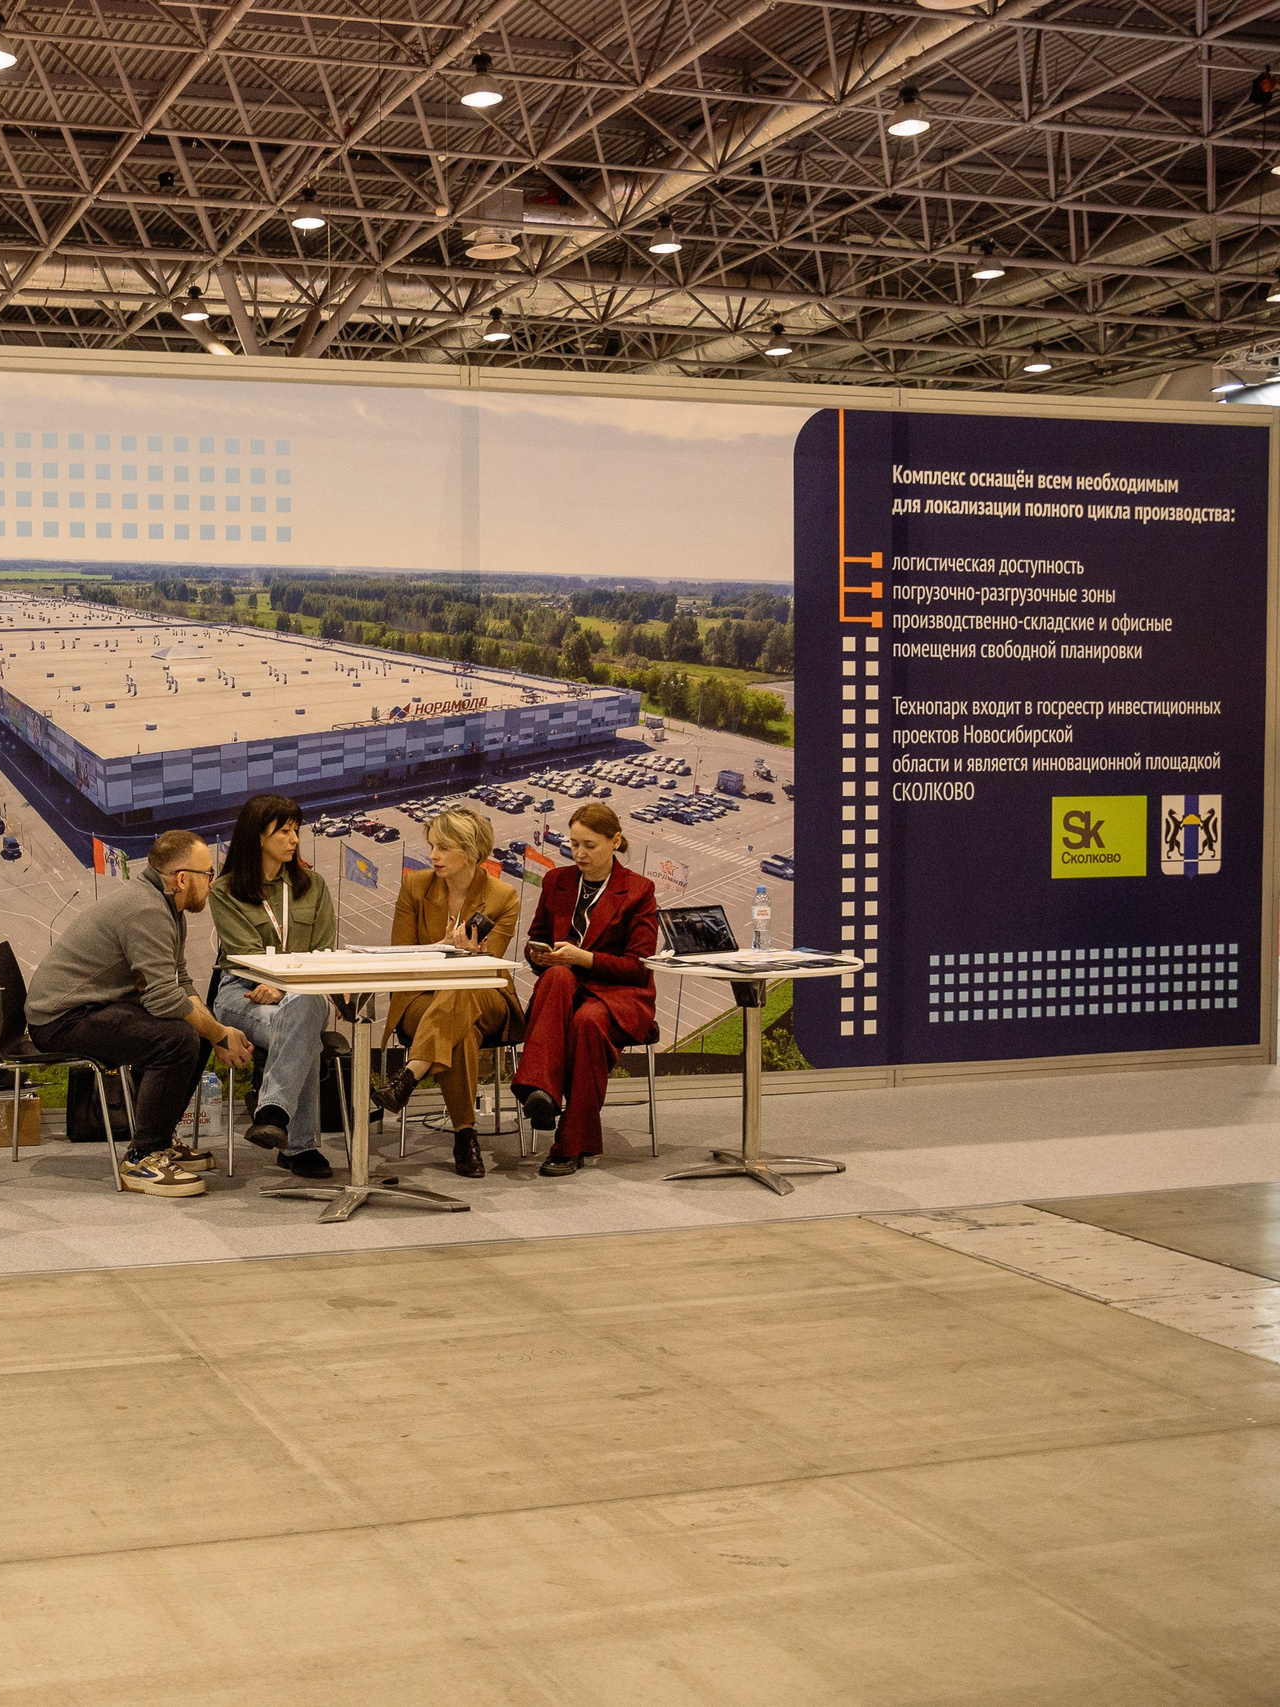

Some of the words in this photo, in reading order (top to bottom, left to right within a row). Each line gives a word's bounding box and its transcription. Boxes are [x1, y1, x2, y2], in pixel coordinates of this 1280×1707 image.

[892, 464, 967, 487] Комплекс
[968, 468, 1034, 491] оснащён
[1037, 474, 1073, 490] всем
[1075, 471, 1179, 495] необходимым
[891, 498, 922, 516] для
[923, 499, 1022, 519] локализации
[1024, 502, 1085, 519] полного
[1087, 504, 1131, 522] цикла
[1134, 505, 1236, 525] производства:
[891, 556, 996, 573] логистическая
[998, 558, 1085, 579] доступность
[892, 585, 1078, 607] погрузочно-разгрузочные
[1081, 588, 1116, 604] зоны
[892, 613, 1095, 634] производственно-складские
[1098, 617, 1108, 631] и
[1110, 612, 1173, 636] офисные
[892, 642, 977, 661] помещения
[980, 639, 1057, 662] свободной
[1060, 644, 1143, 664] планировки
[892, 695, 969, 720] Технопарк
[972, 700, 1022, 718] входит
[1024, 700, 1033, 716] в
[1036, 700, 1105, 720] госреестр
[1107, 700, 1222, 718] инвестиционных
[892, 729, 960, 749] проектов
[963, 724, 1074, 748] Новосибирской
[892, 753, 950, 773] области
[953, 758, 963, 772] и
[966, 757, 1029, 773] является
[1032, 752, 1142, 774] инновационной
[1145, 751, 1221, 773] площадкой
[892, 781, 975, 802] СКОЛКОВО
[1062, 810, 1106, 850] Sk
[1061, 851, 1122, 865] Сколково
